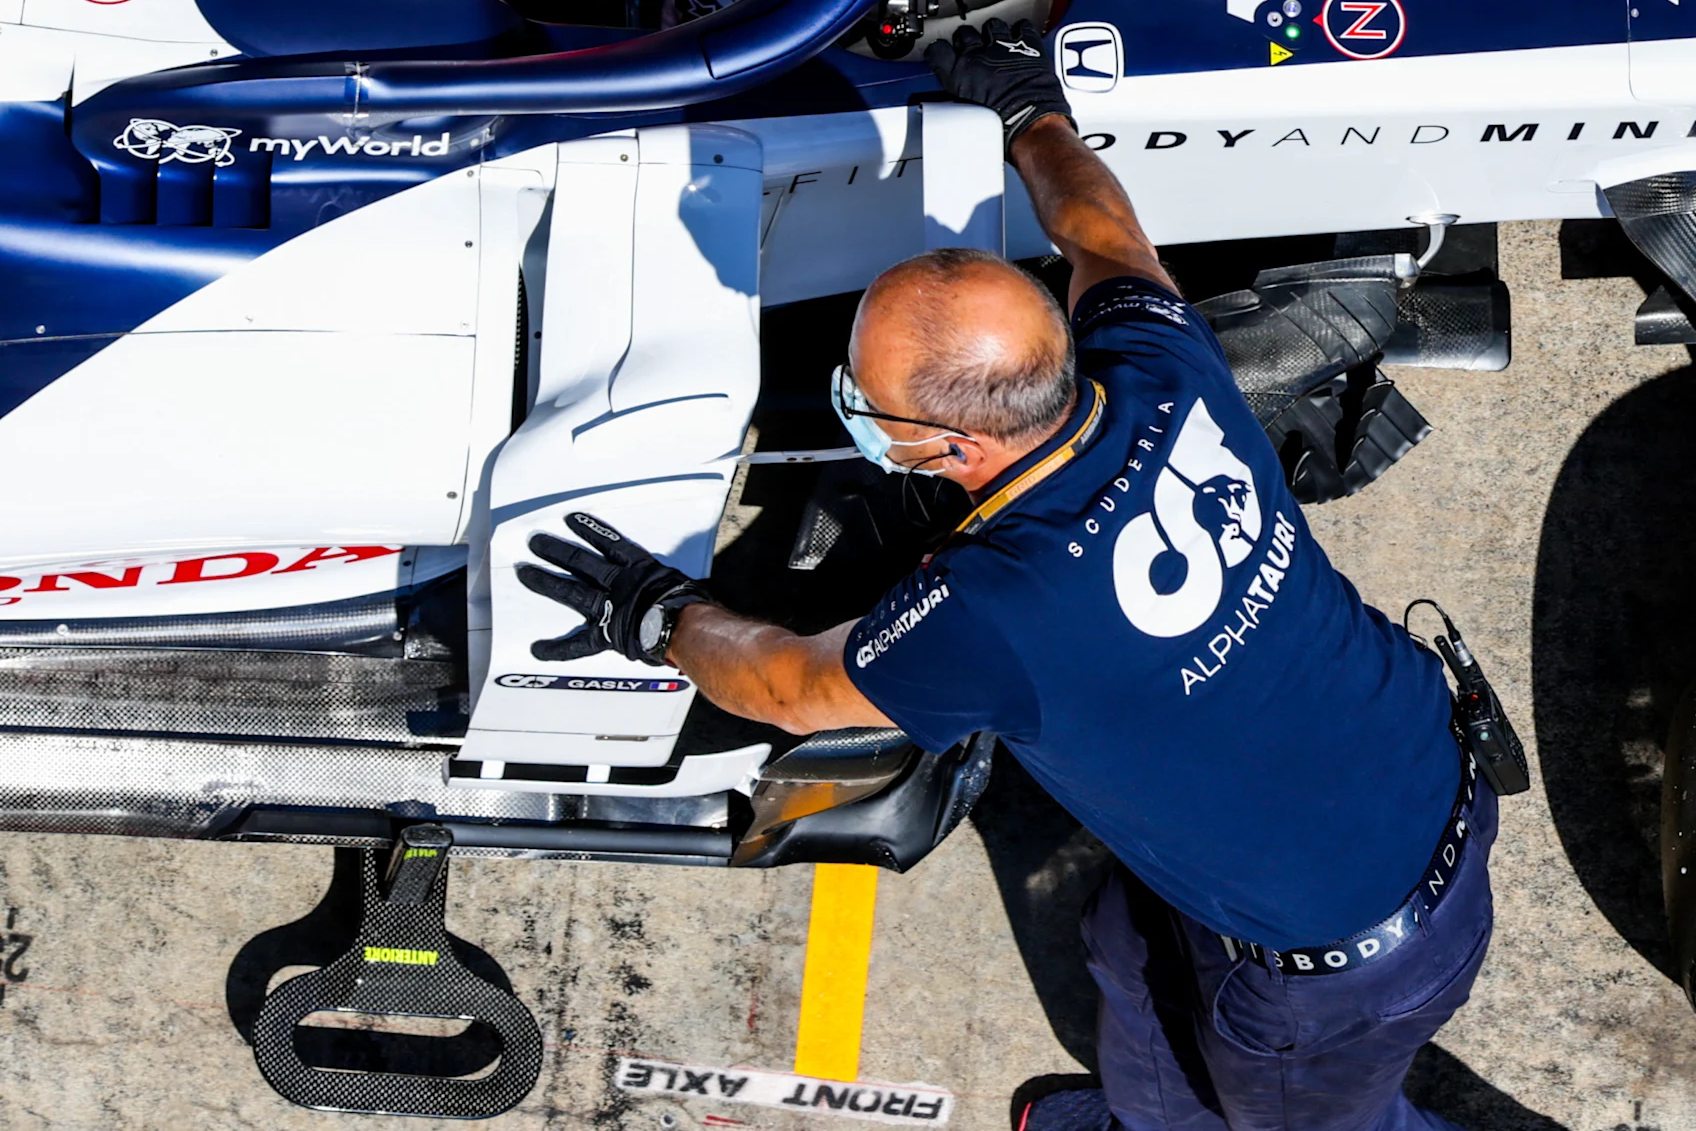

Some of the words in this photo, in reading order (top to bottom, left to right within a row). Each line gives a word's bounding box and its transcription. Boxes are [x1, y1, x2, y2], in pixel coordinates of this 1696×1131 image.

[249, 132, 451, 162] myWorld
[1067, 401, 1175, 558] SCUDERIA
[873, 583, 950, 657] ALPHATAURI
[1180, 511, 1296, 695] ALPHATAURI
[567, 679, 643, 690] GASLY
[363, 946, 440, 966] ANTERIORE
[622, 1062, 749, 1098] AXLE
[782, 1082, 945, 1120] FRONT
